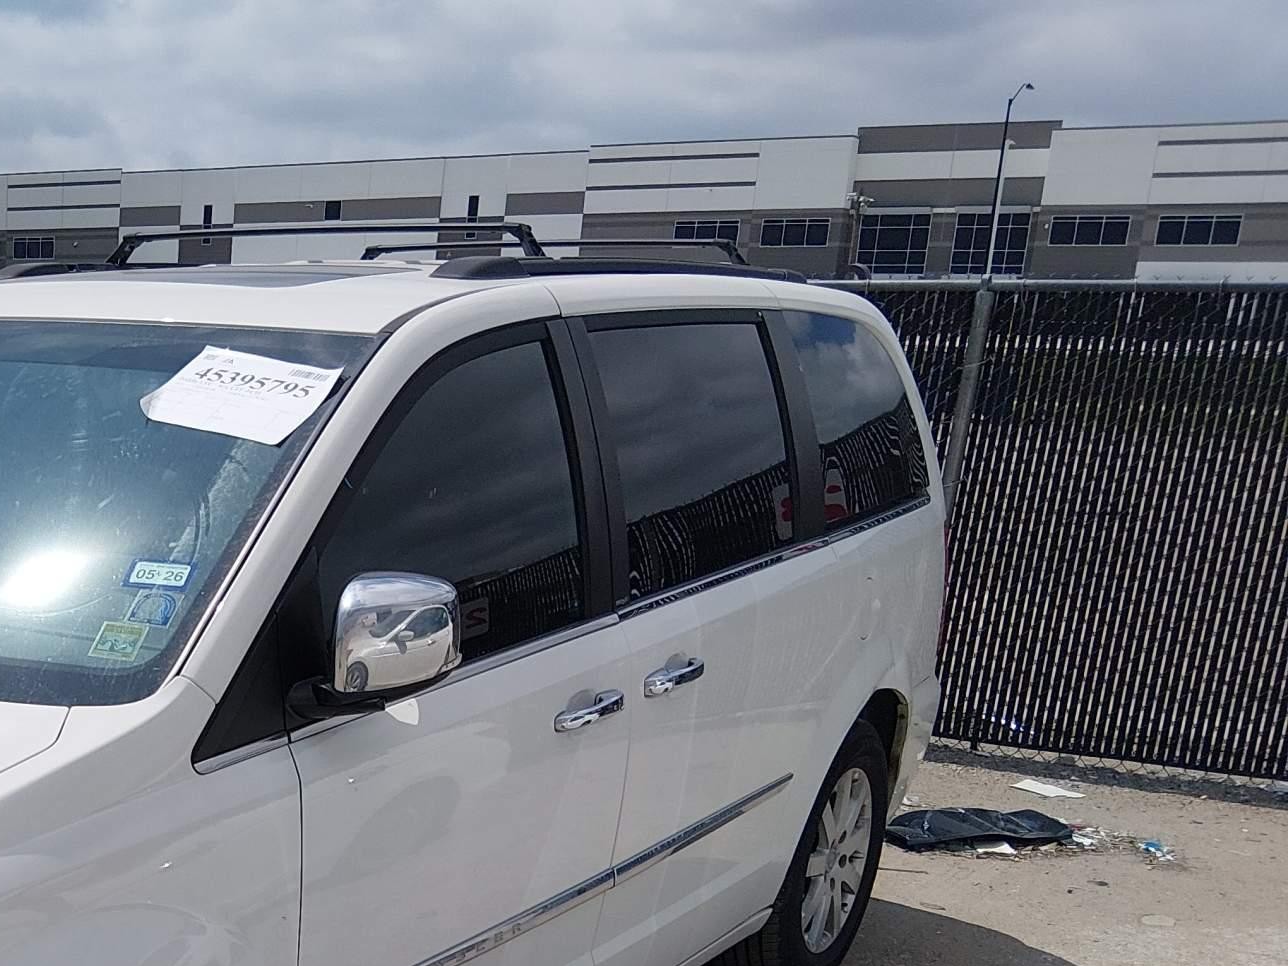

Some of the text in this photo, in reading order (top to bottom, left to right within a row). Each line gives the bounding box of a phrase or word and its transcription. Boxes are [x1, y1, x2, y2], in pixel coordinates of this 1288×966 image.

[194, 366, 316, 398] 45395795
[135, 568, 185, 582] 05 26
